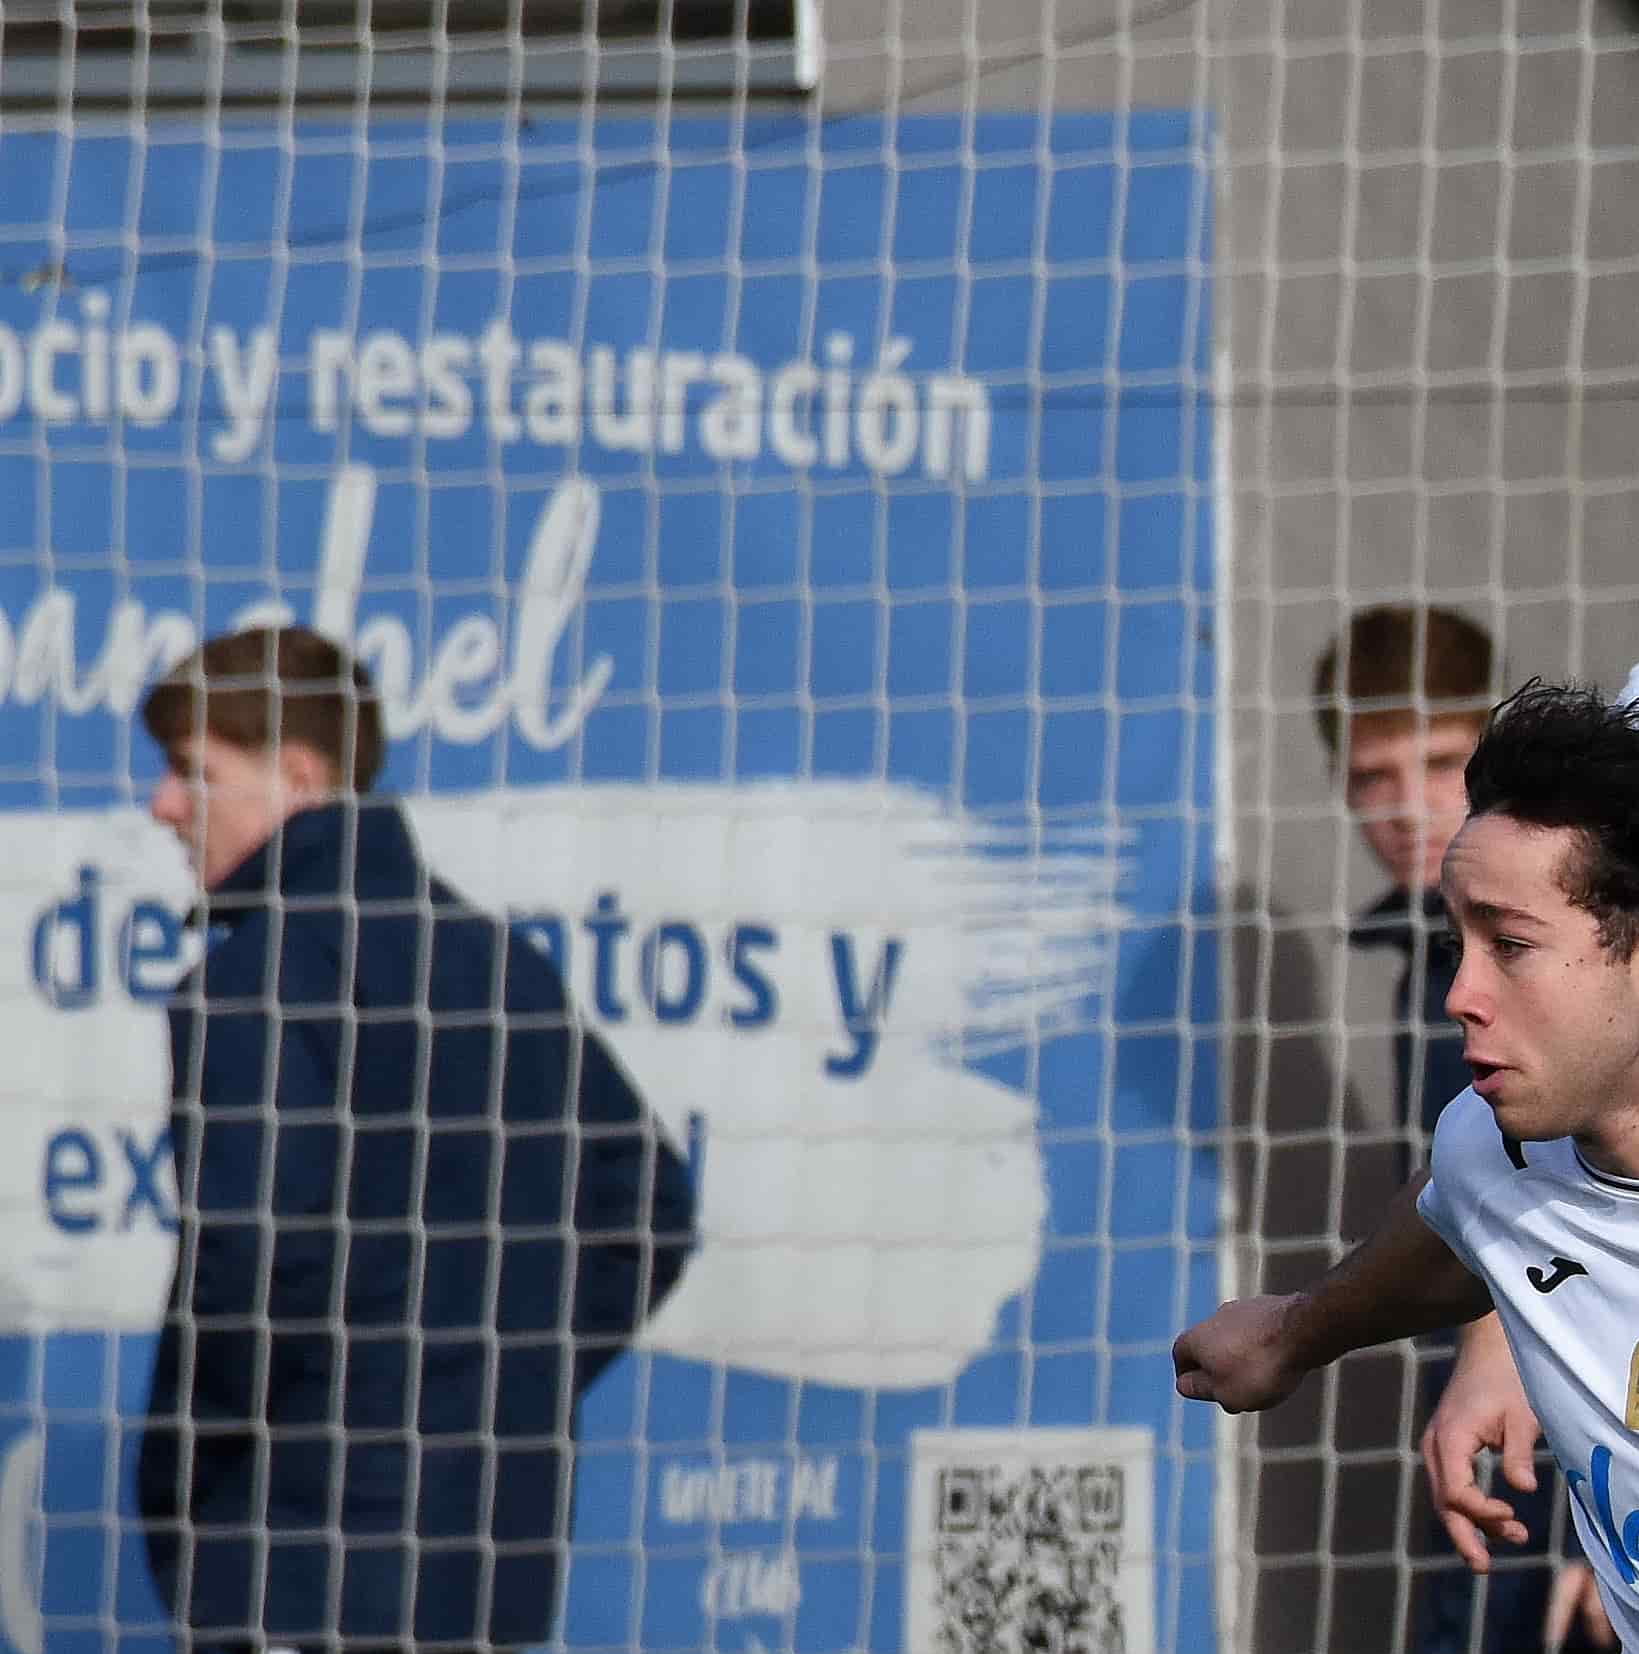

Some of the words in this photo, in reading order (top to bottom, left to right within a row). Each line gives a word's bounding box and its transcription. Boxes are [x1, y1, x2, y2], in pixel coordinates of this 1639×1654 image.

[210, 323, 279, 463] y
[309, 322, 993, 482] restauración
[822, 929, 908, 1082] y
